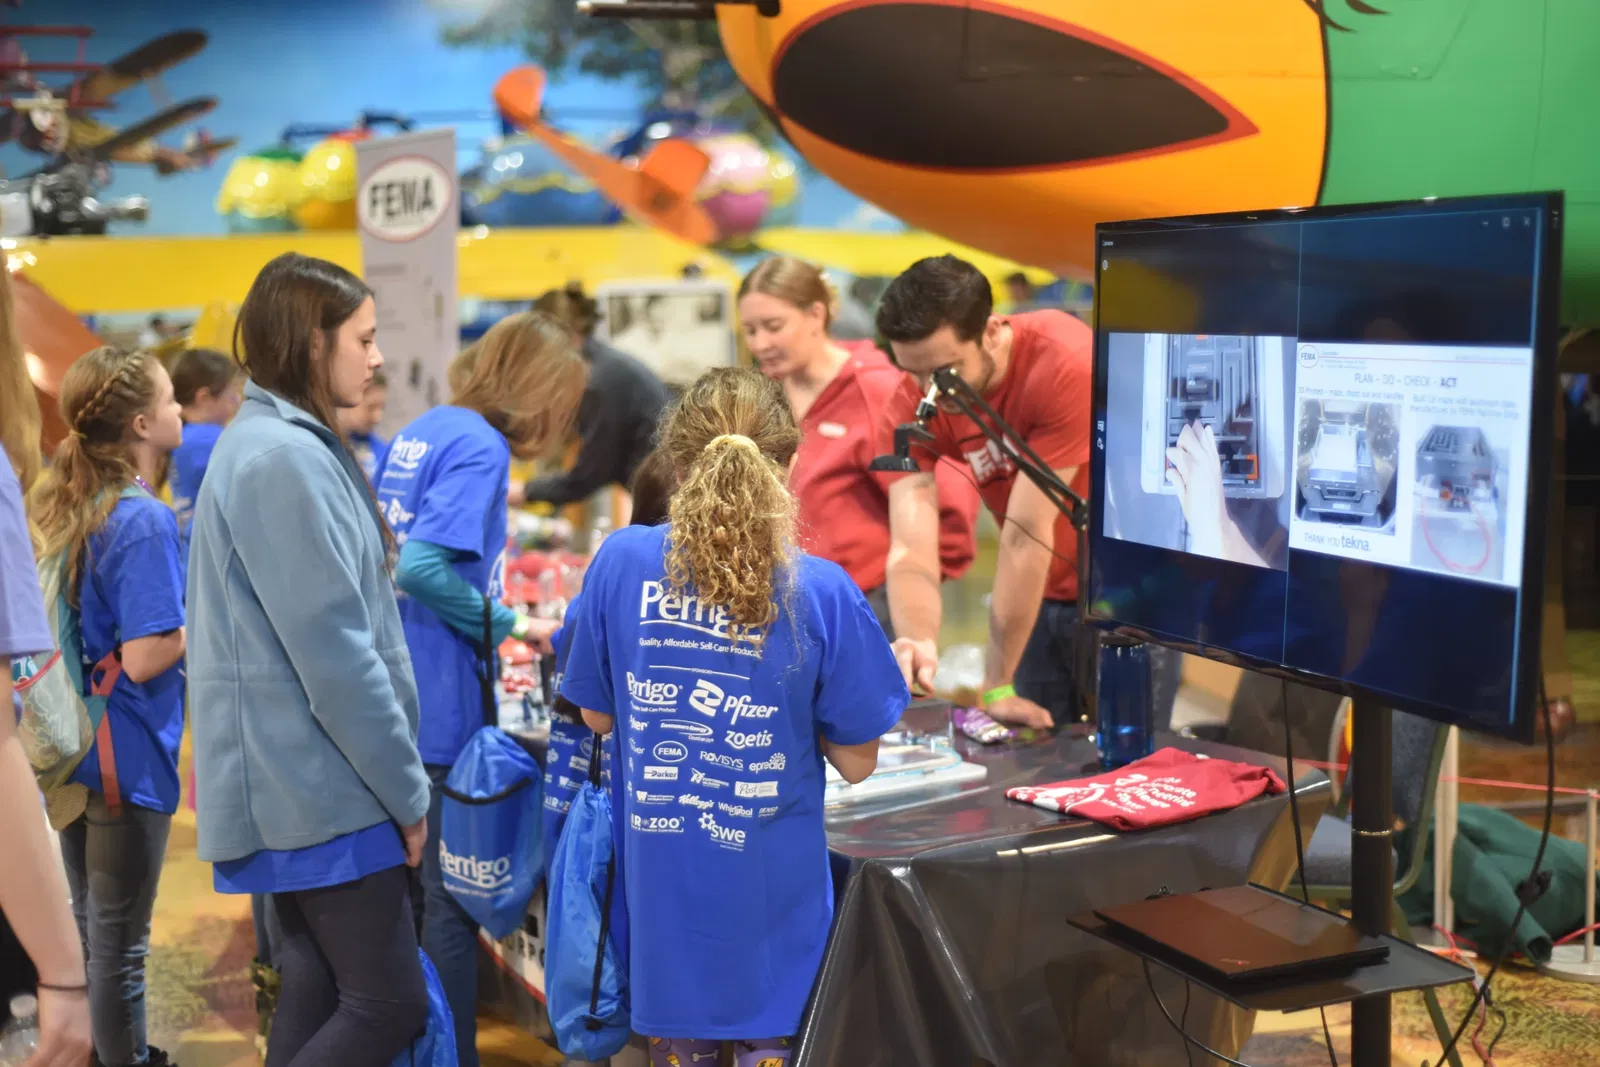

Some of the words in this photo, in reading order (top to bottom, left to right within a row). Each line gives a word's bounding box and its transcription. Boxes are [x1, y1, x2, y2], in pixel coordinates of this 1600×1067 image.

[368, 175, 435, 220] FEMA
[1300, 352, 1316, 361] FEMA
[1354, 372, 1374, 384] PLAN
[1439, 376, 1457, 388] ACT
[1341, 534, 1370, 551] tekna
[640, 580, 761, 639] Perrig
[639, 637, 662, 648] Quality,
[663, 638, 699, 649] Affordable
[700, 641, 729, 653] Self-Care
[724, 729, 773, 750] zoetis
[658, 747, 682, 756] FEMA
[651, 769, 677, 779] Parker
[739, 784, 757, 795] Post
[718, 802, 753, 816] Whirlpool
